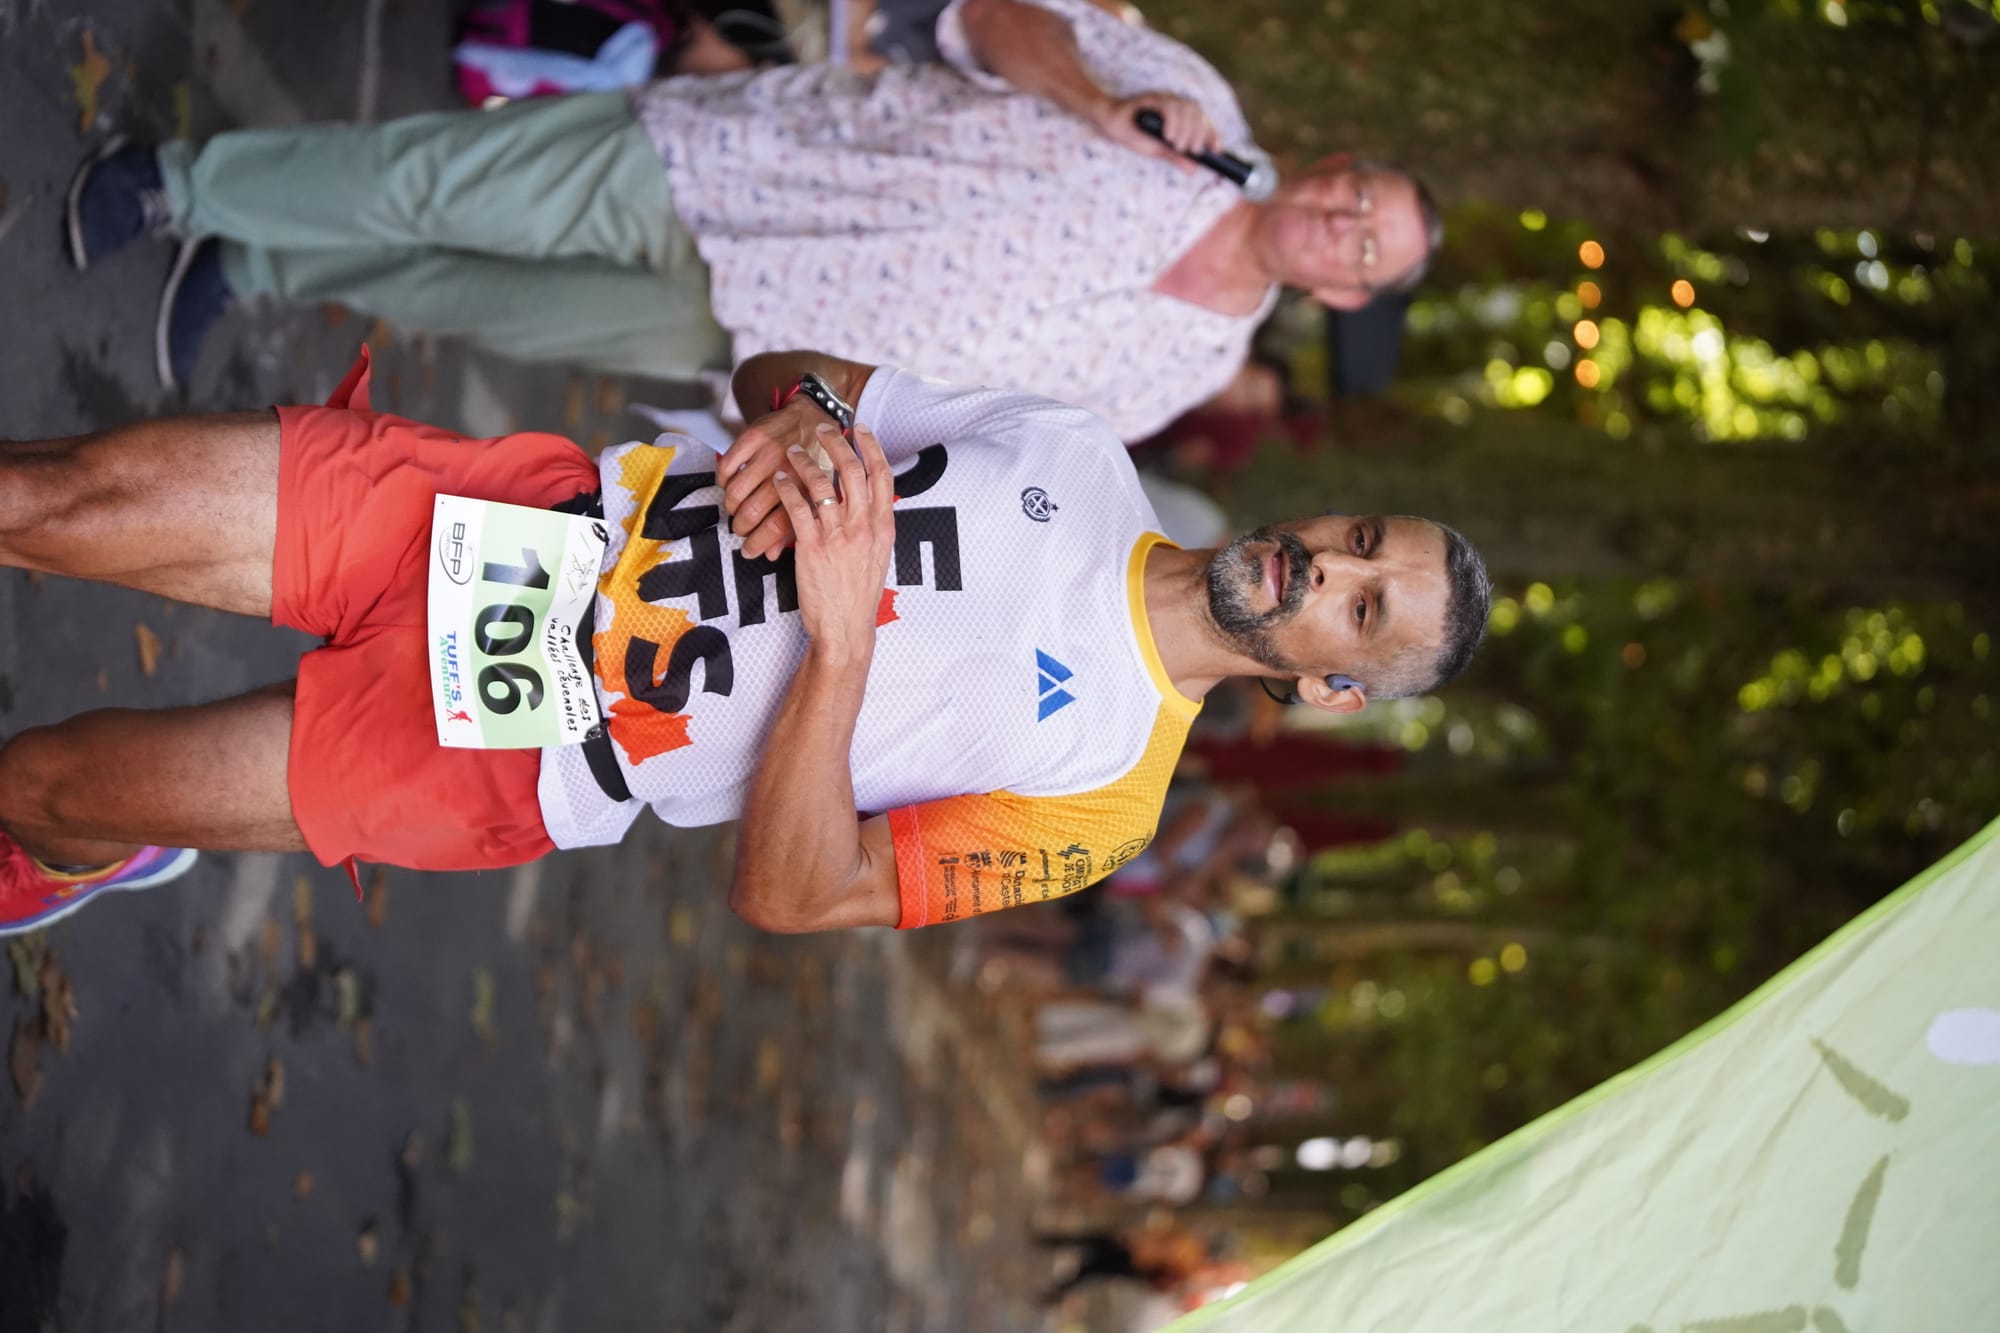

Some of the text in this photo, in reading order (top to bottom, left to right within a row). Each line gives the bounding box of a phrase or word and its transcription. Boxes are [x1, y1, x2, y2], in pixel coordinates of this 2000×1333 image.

[450, 522, 466, 575] BFP
[439, 636, 453, 708] Aventure
[447, 631, 462, 702] TUFF'S
[475, 547, 550, 715] 106
[561, 625, 592, 721] Challenge des
[547, 617, 578, 731] vallées cévenoles
